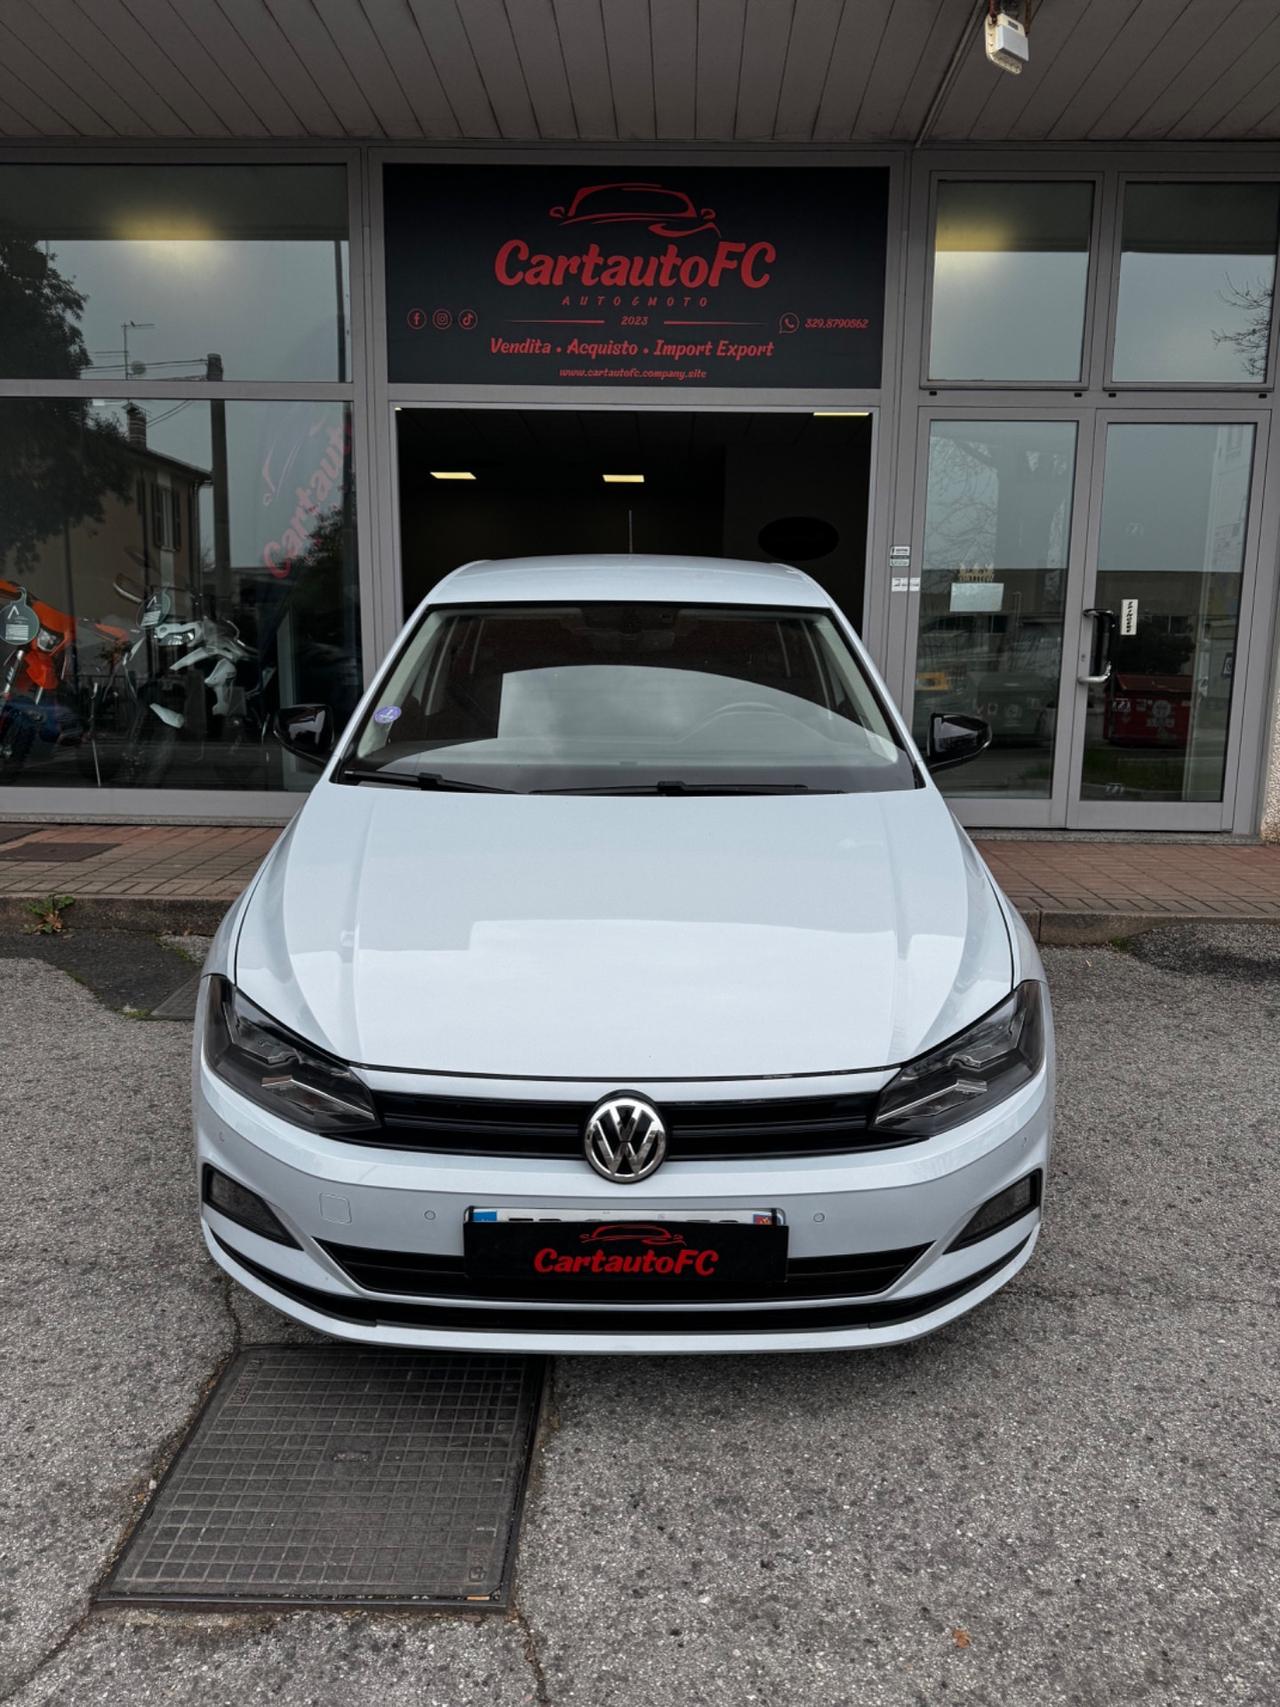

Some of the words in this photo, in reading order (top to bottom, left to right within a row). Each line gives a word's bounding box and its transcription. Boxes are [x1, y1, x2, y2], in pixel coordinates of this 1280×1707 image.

[494, 239, 777, 289] CartautoFC
[620, 315, 649, 326] 2023
[489, 336, 552, 355] Vendita
[566, 338, 639, 360] Acquisto
[653, 339, 713, 361] Import
[716, 340, 775, 361] Export
[263, 412, 352, 579] Cartaut
[533, 1247, 720, 1277] CartautoFC
